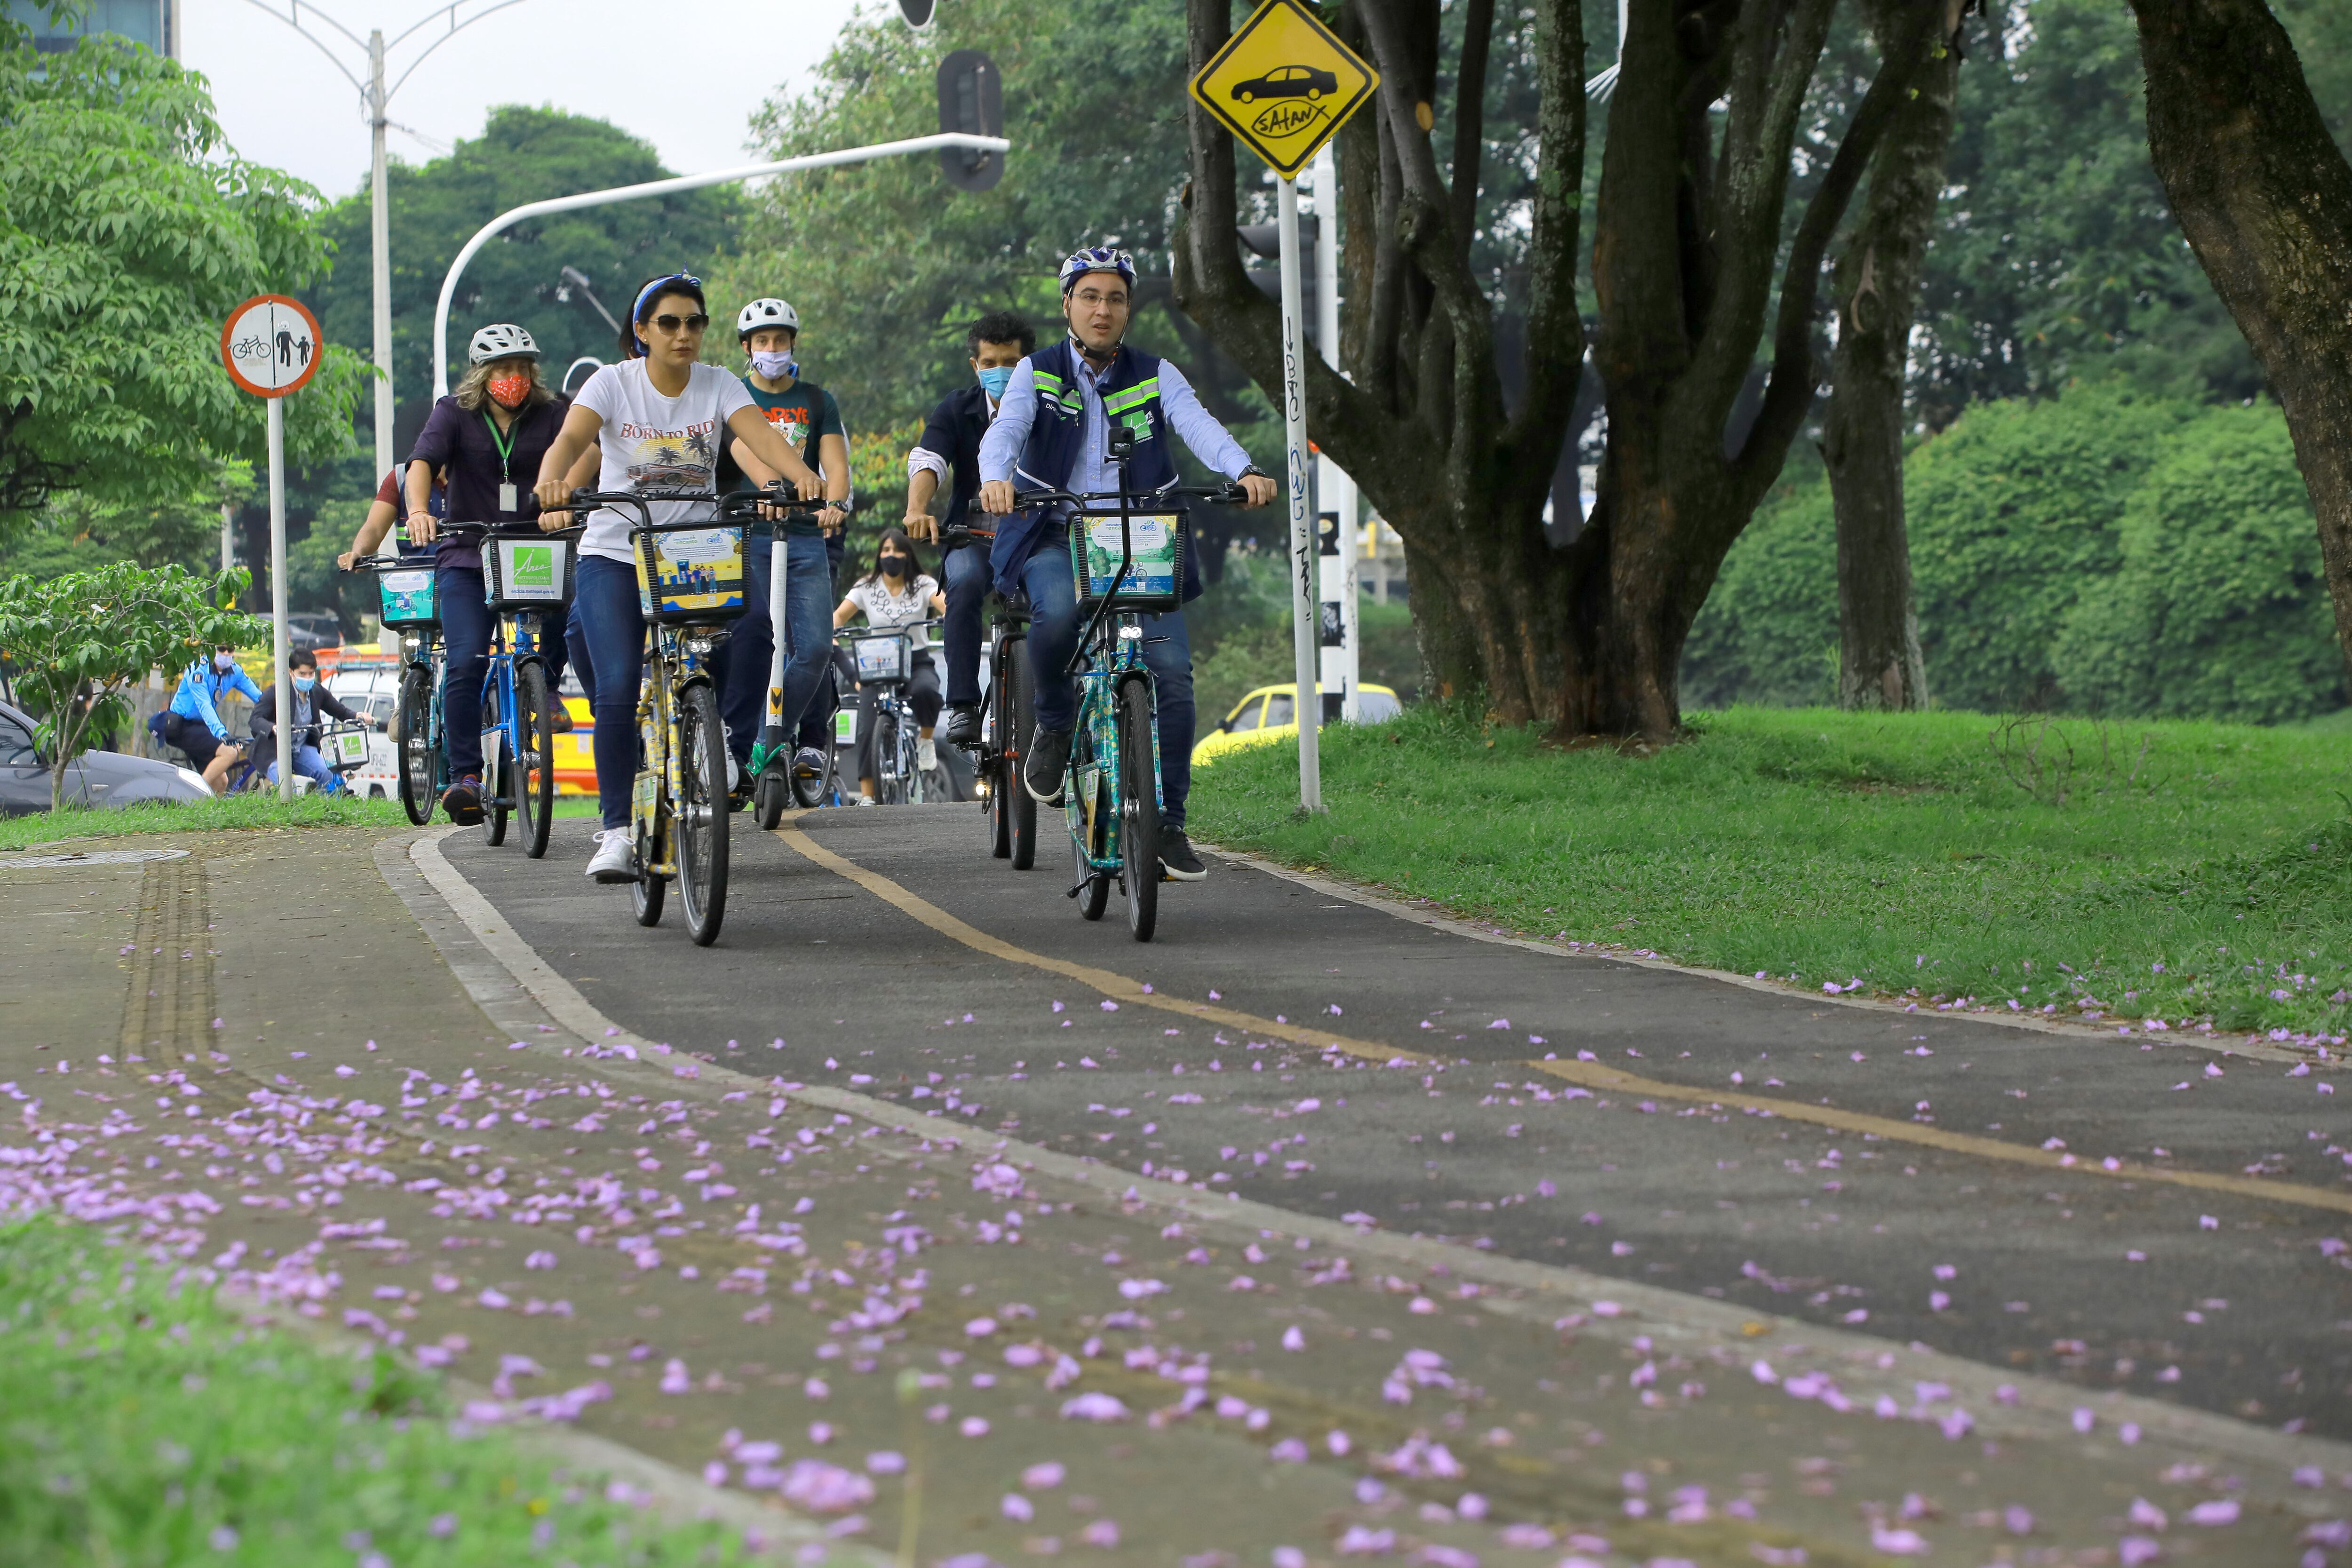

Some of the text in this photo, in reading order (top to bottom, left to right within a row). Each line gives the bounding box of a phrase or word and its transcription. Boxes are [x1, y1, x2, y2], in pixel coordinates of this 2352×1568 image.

[620, 422, 664, 440] BORN
[666, 430, 683, 440] TO
[685, 419, 715, 437] RID
